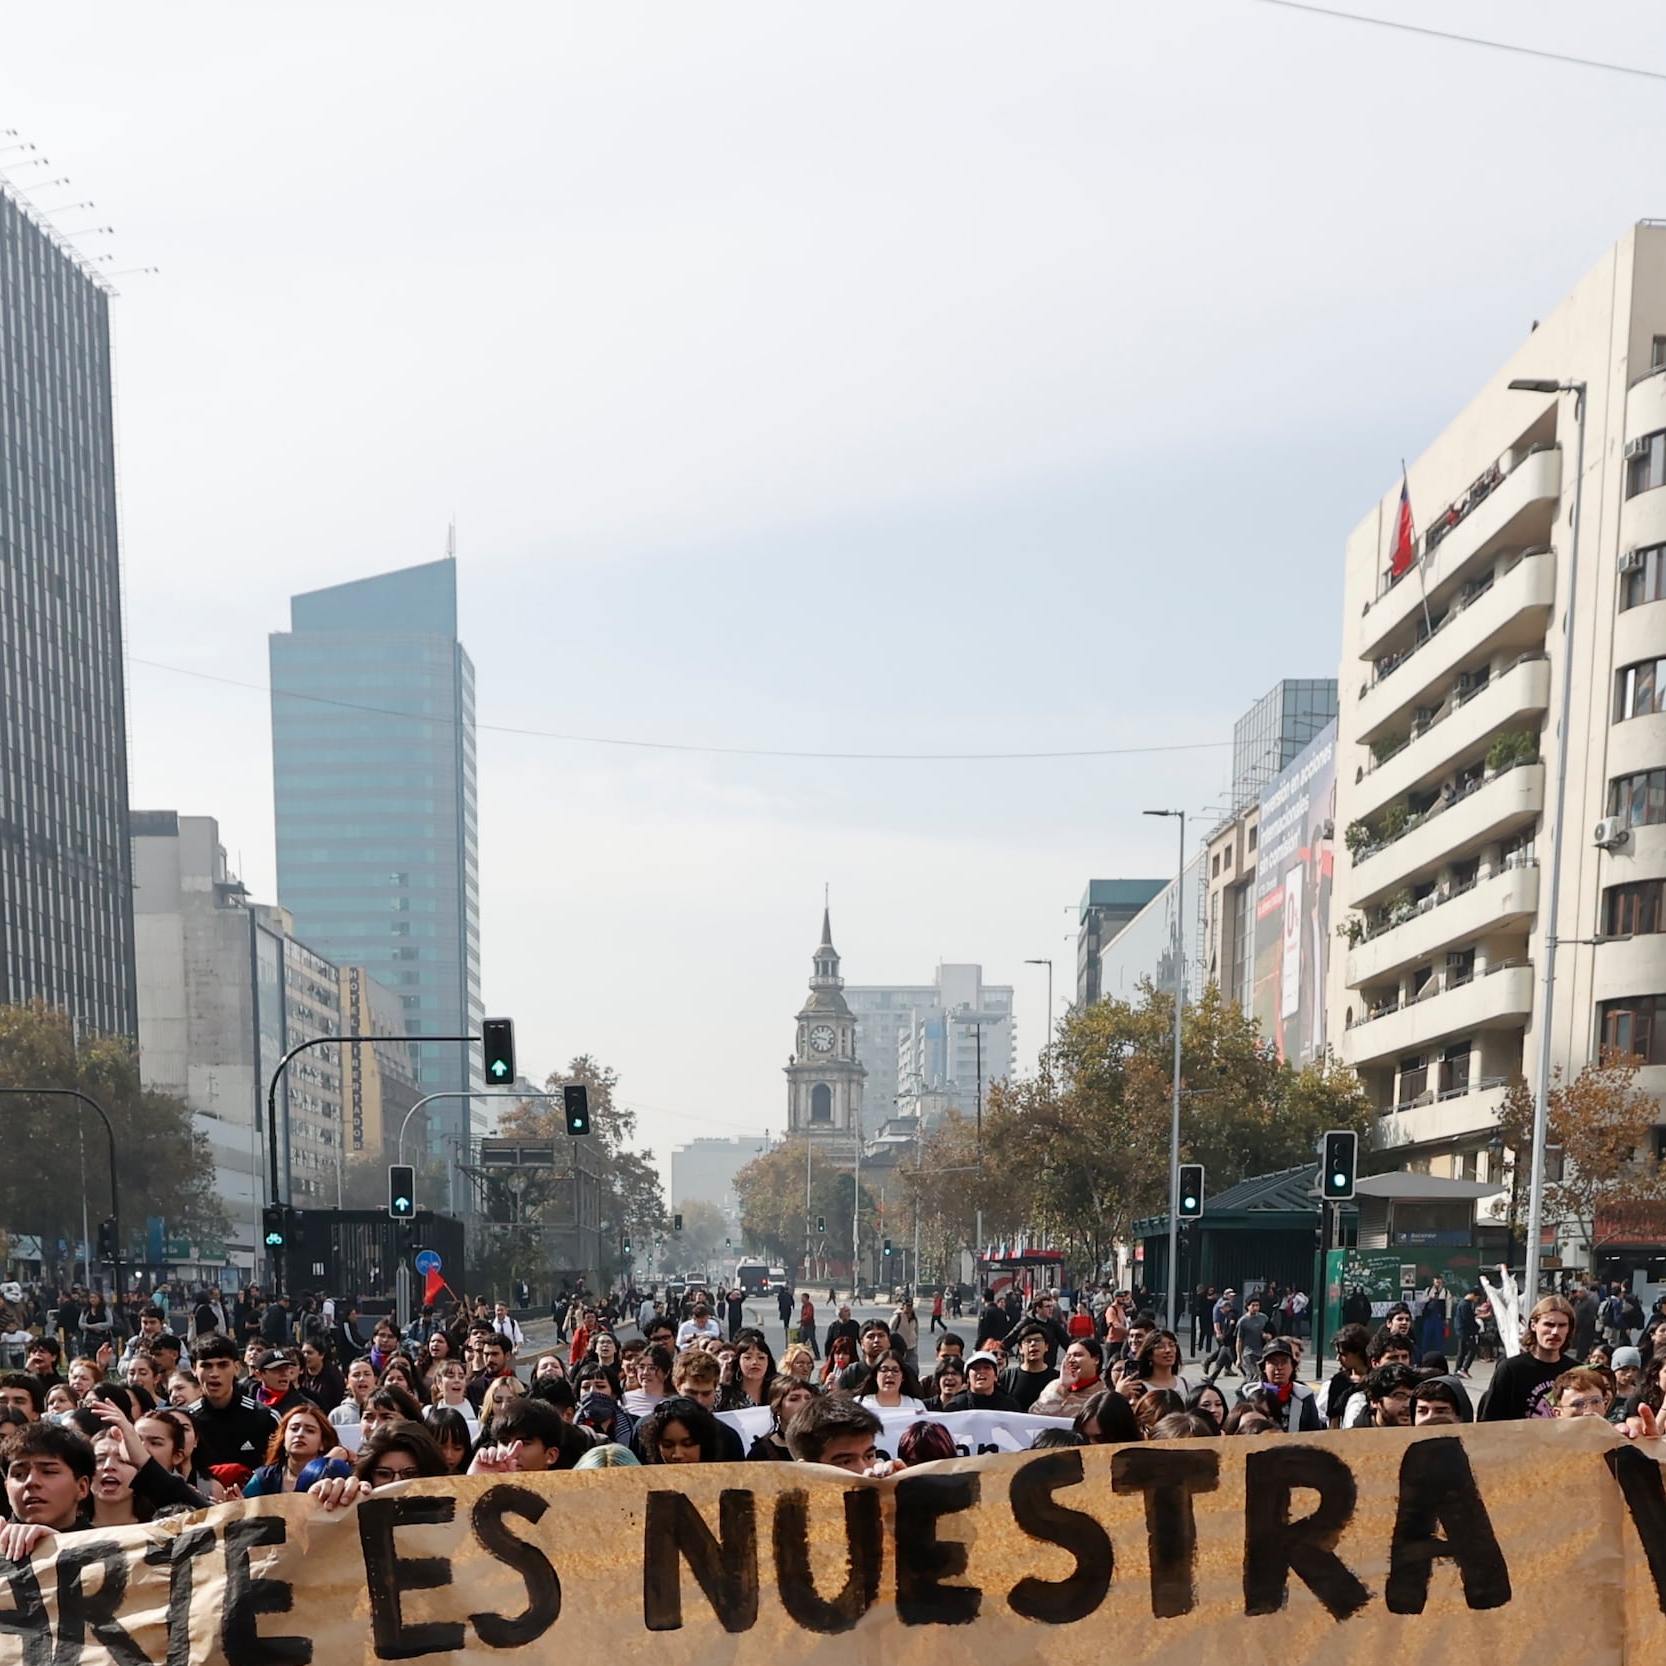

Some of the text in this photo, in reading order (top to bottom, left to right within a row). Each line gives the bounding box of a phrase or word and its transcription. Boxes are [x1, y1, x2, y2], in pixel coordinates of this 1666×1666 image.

[349, 970, 359, 1027] HOTEL
[358, 1485, 563, 1660] ES
[652, 1440, 1513, 1635] NUESTRA
